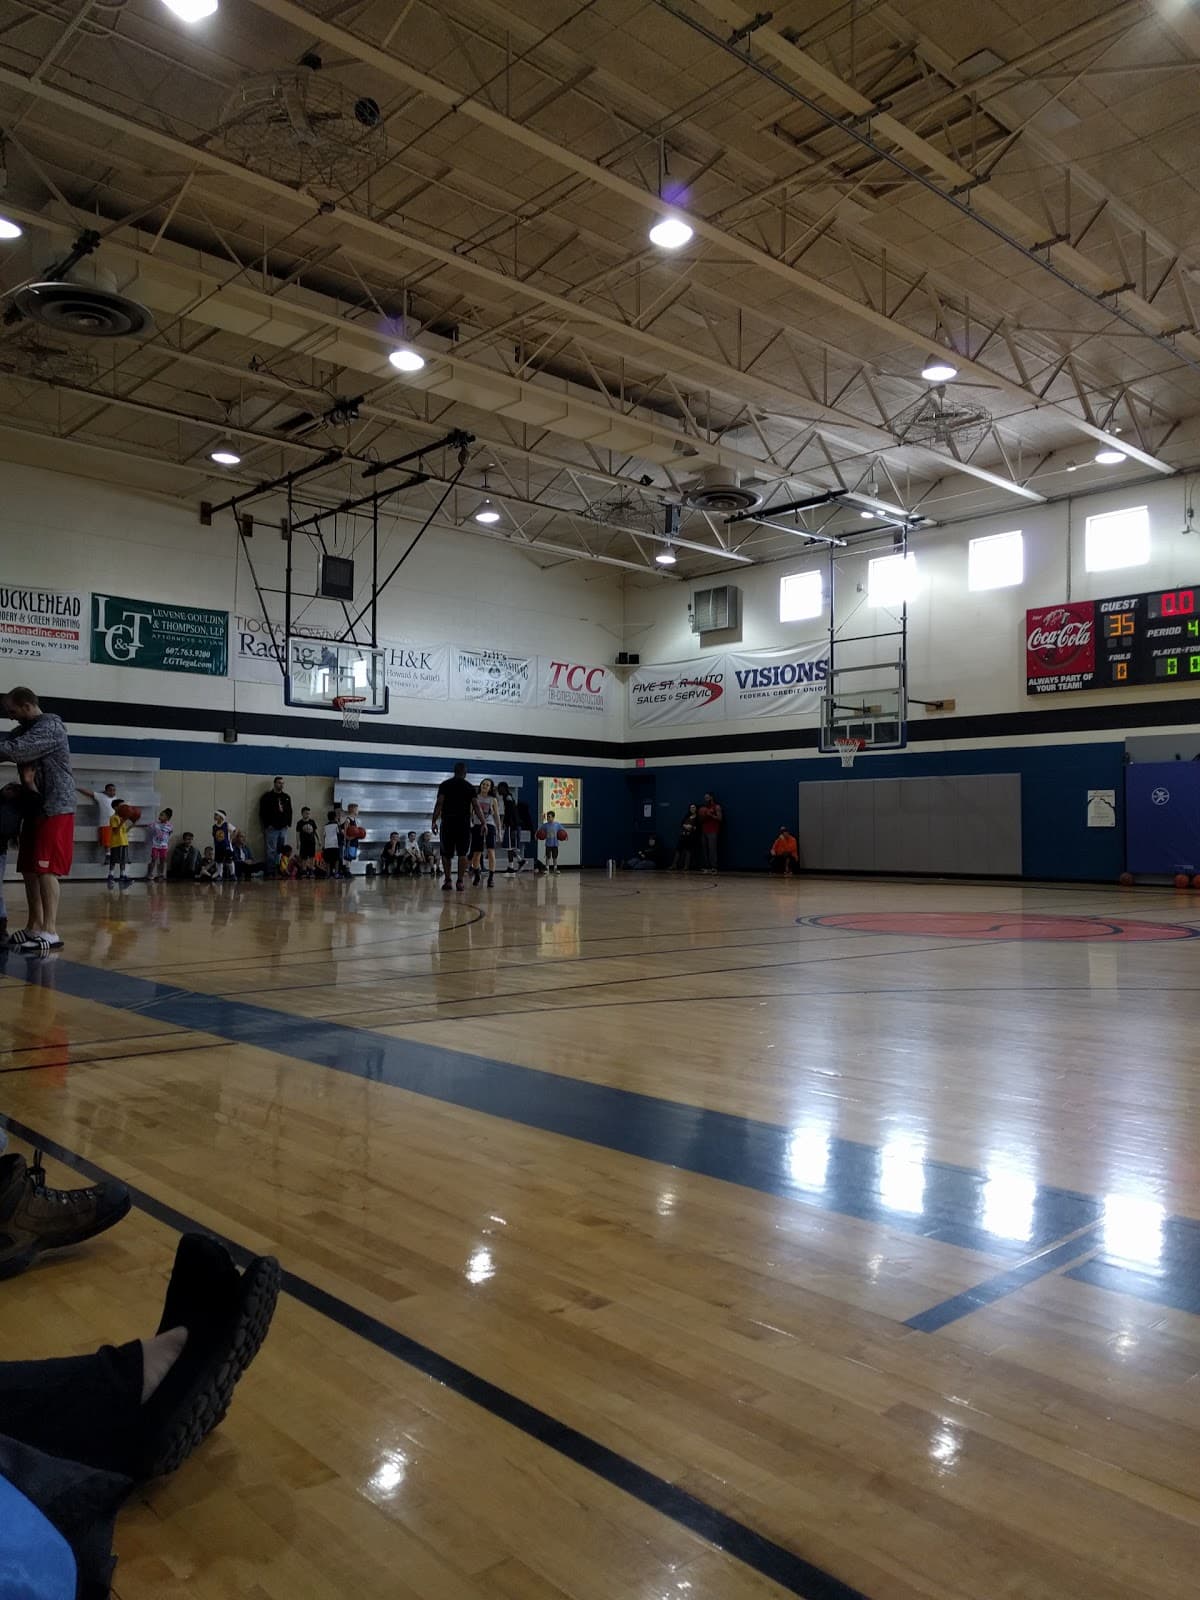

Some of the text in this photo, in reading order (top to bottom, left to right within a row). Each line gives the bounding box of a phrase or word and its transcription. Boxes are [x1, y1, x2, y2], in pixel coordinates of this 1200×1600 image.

[1100, 599, 1138, 612] GUEST
[28, 614, 50, 626] SCREEN
[52, 617, 80, 629] PRINTING
[152, 608, 224, 625] LEVENE GOULDIN
[1109, 612, 1135, 637] 35
[152, 619, 159, 629] &
[209, 626, 224, 637] LLP
[234, 615, 285, 636] TIOGA
[1146, 626, 1181, 638] PERIOD
[1188, 619, 1199, 637] 4
[239, 632, 315, 670] Racing
[1108, 652, 1131, 661] FOULS
[549, 661, 605, 694] TCC
[735, 660, 829, 689] VISIONS
[1028, 672, 1093, 686] ALWAYS PART OF
[1117, 663, 1127, 680] 0
[632, 673, 723, 694] FIVE STR AUTO
[1036, 681, 1082, 693] YOUR TEAM!
[636, 694, 666, 705] SALES
[740, 691, 770, 700] FEDERAL
[773, 689, 800, 697] CREDIT
